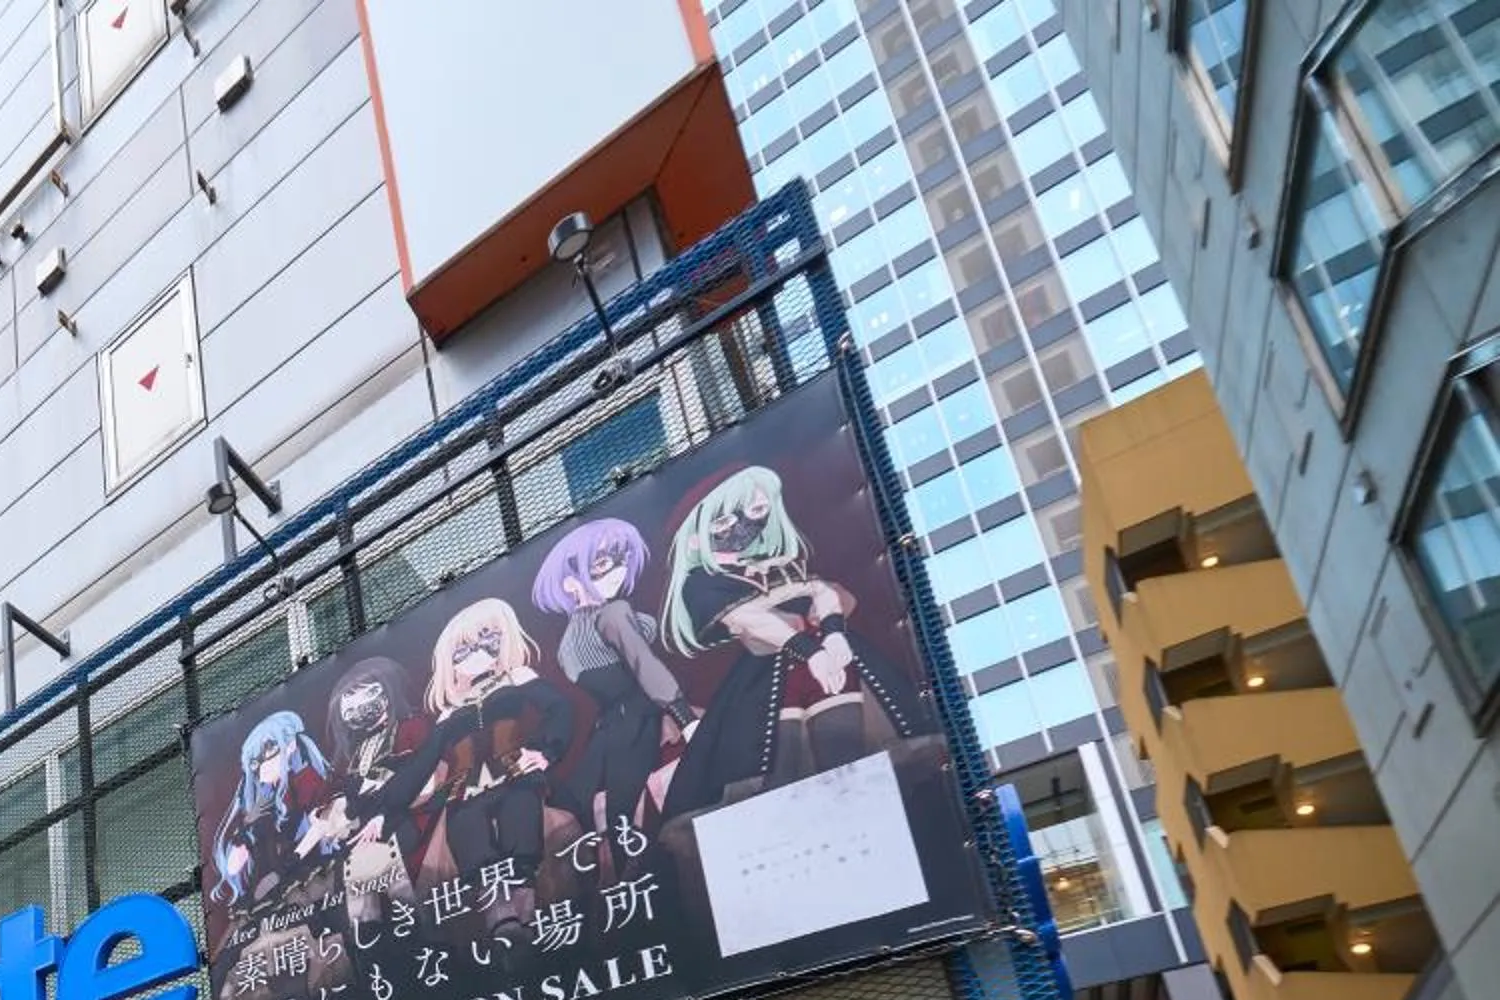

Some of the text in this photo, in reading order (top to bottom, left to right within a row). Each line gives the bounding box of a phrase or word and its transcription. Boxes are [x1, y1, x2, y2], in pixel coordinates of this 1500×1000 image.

[227, 864, 407, 948] Ave Mujica 1st Single
[235, 857, 527, 997] 素晴らしき世界
[556, 813, 649, 873] でも
